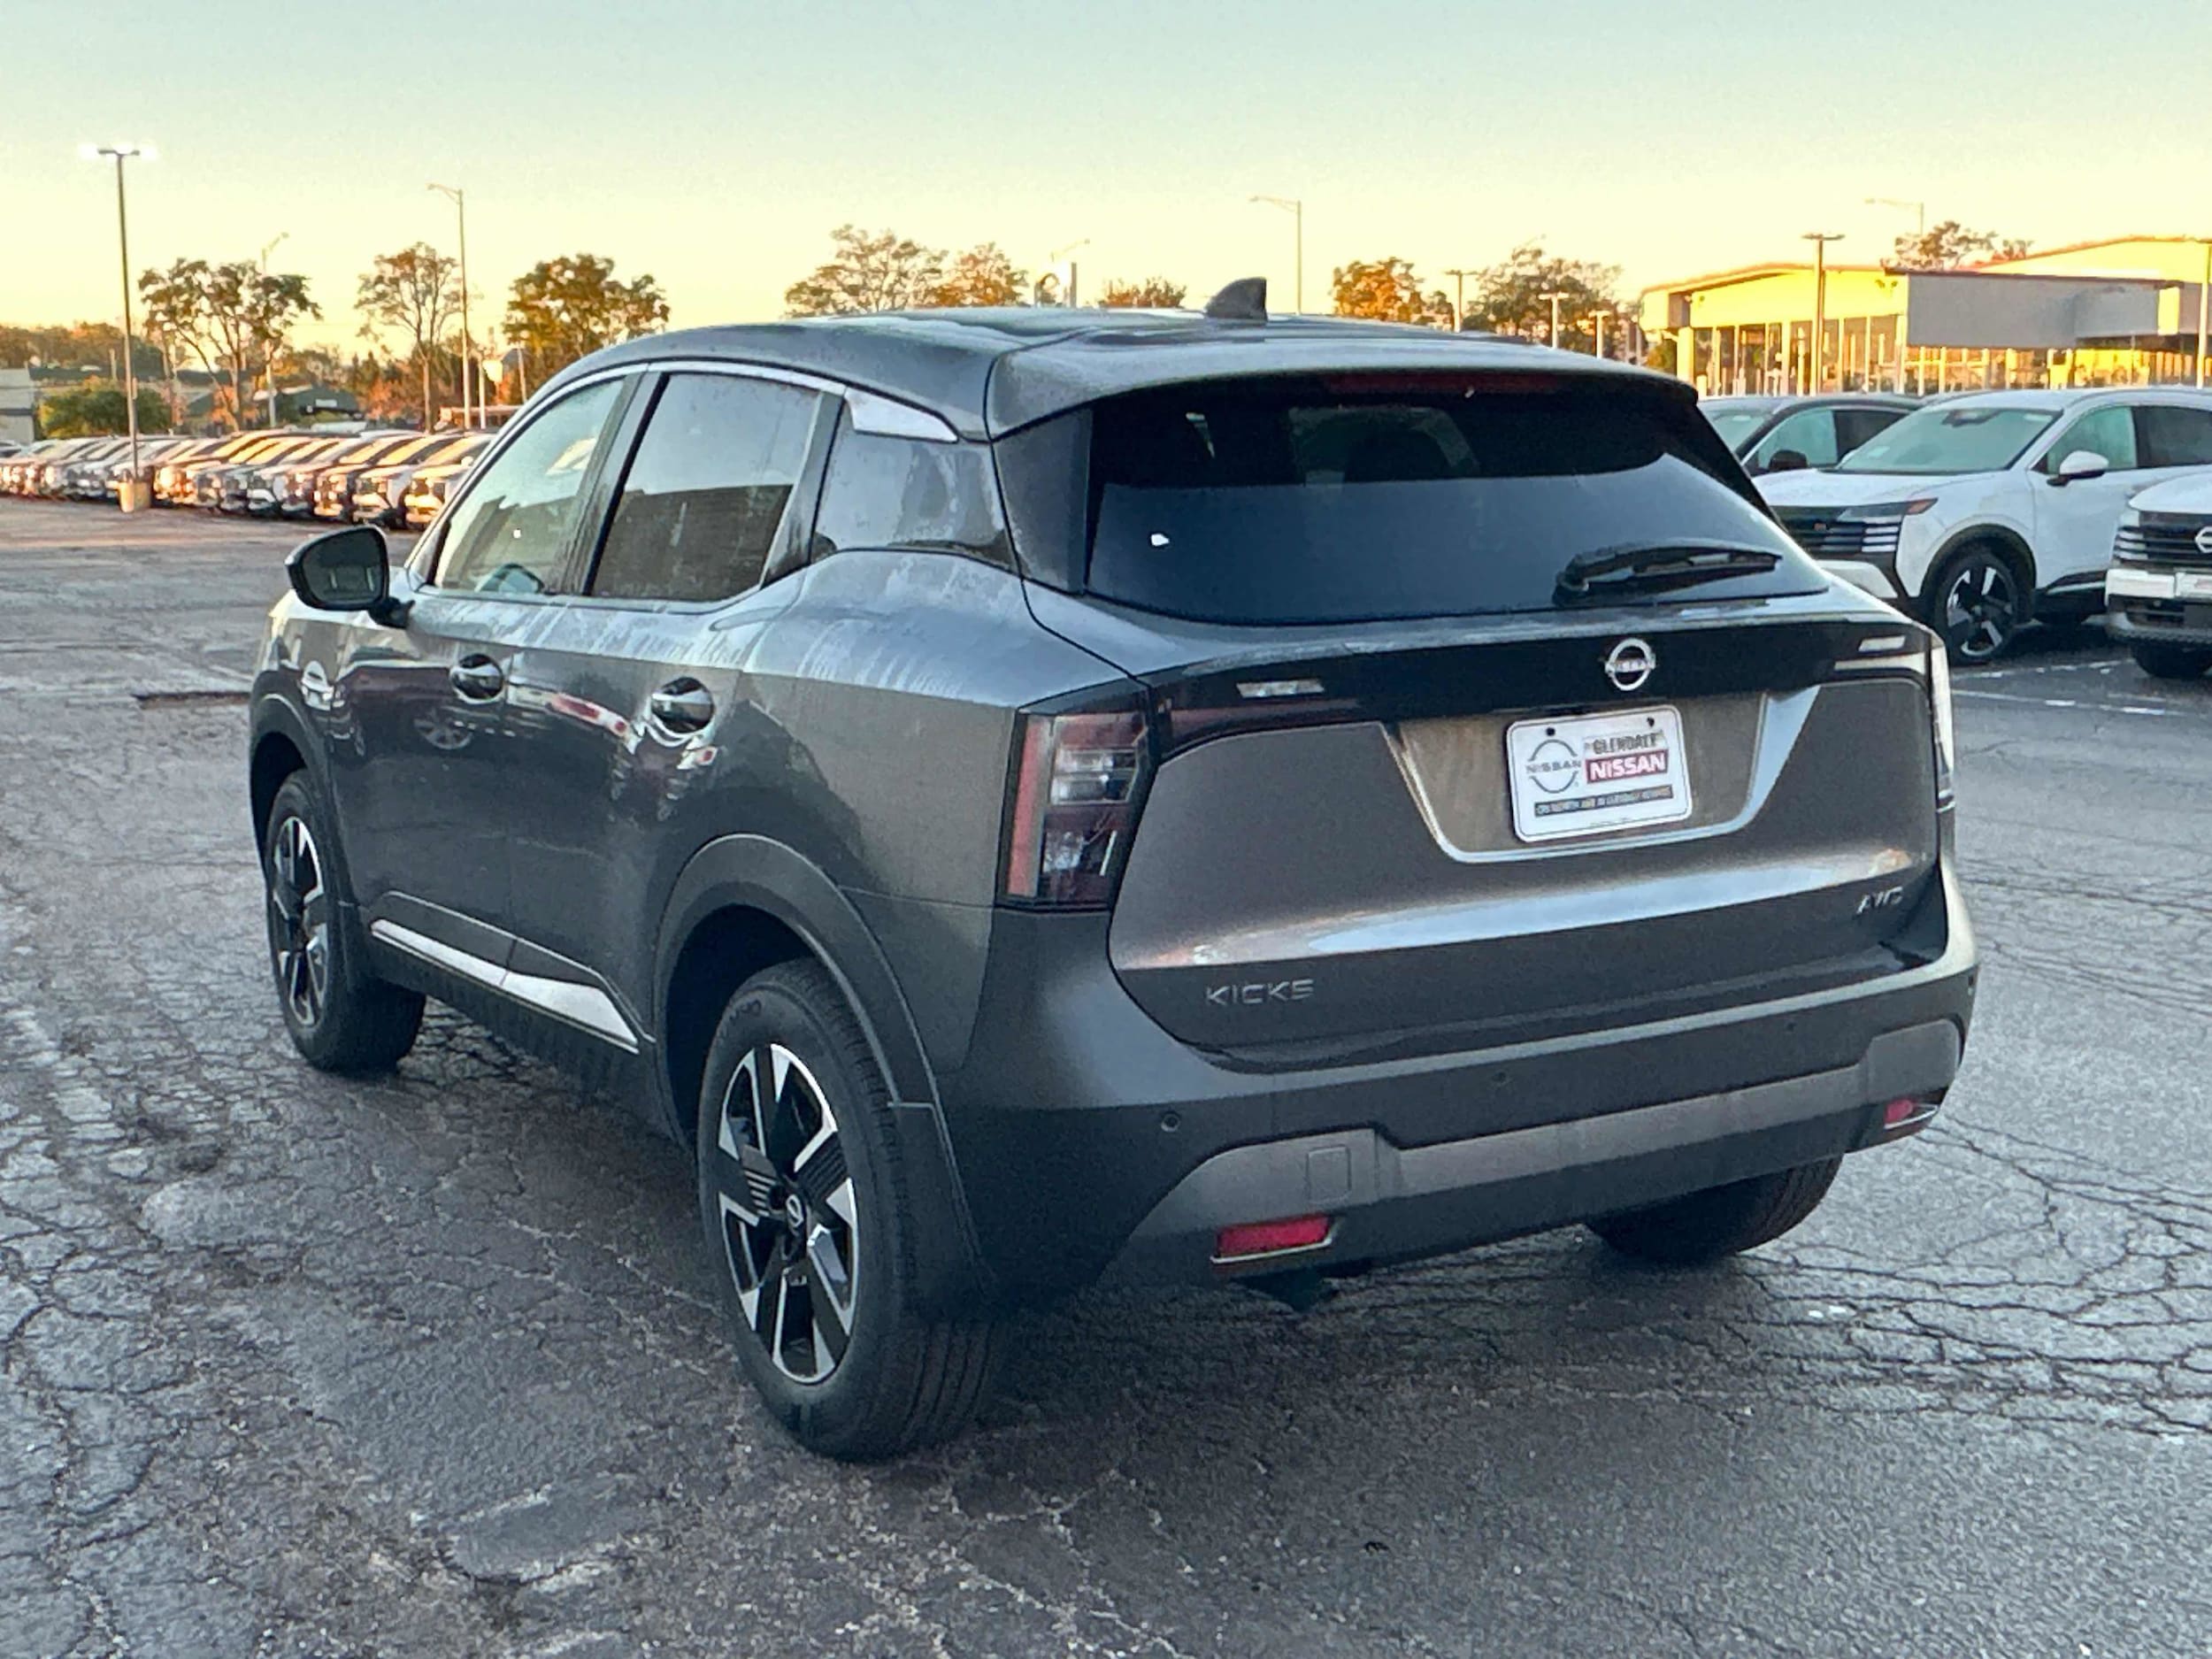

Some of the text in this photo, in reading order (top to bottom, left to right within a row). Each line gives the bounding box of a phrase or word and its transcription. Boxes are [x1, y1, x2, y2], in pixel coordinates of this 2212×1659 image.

[1526, 760, 1581, 774] NISSAN
[1590, 753, 1666, 780] NISSAN
[1206, 979, 1315, 1005] KICKS
